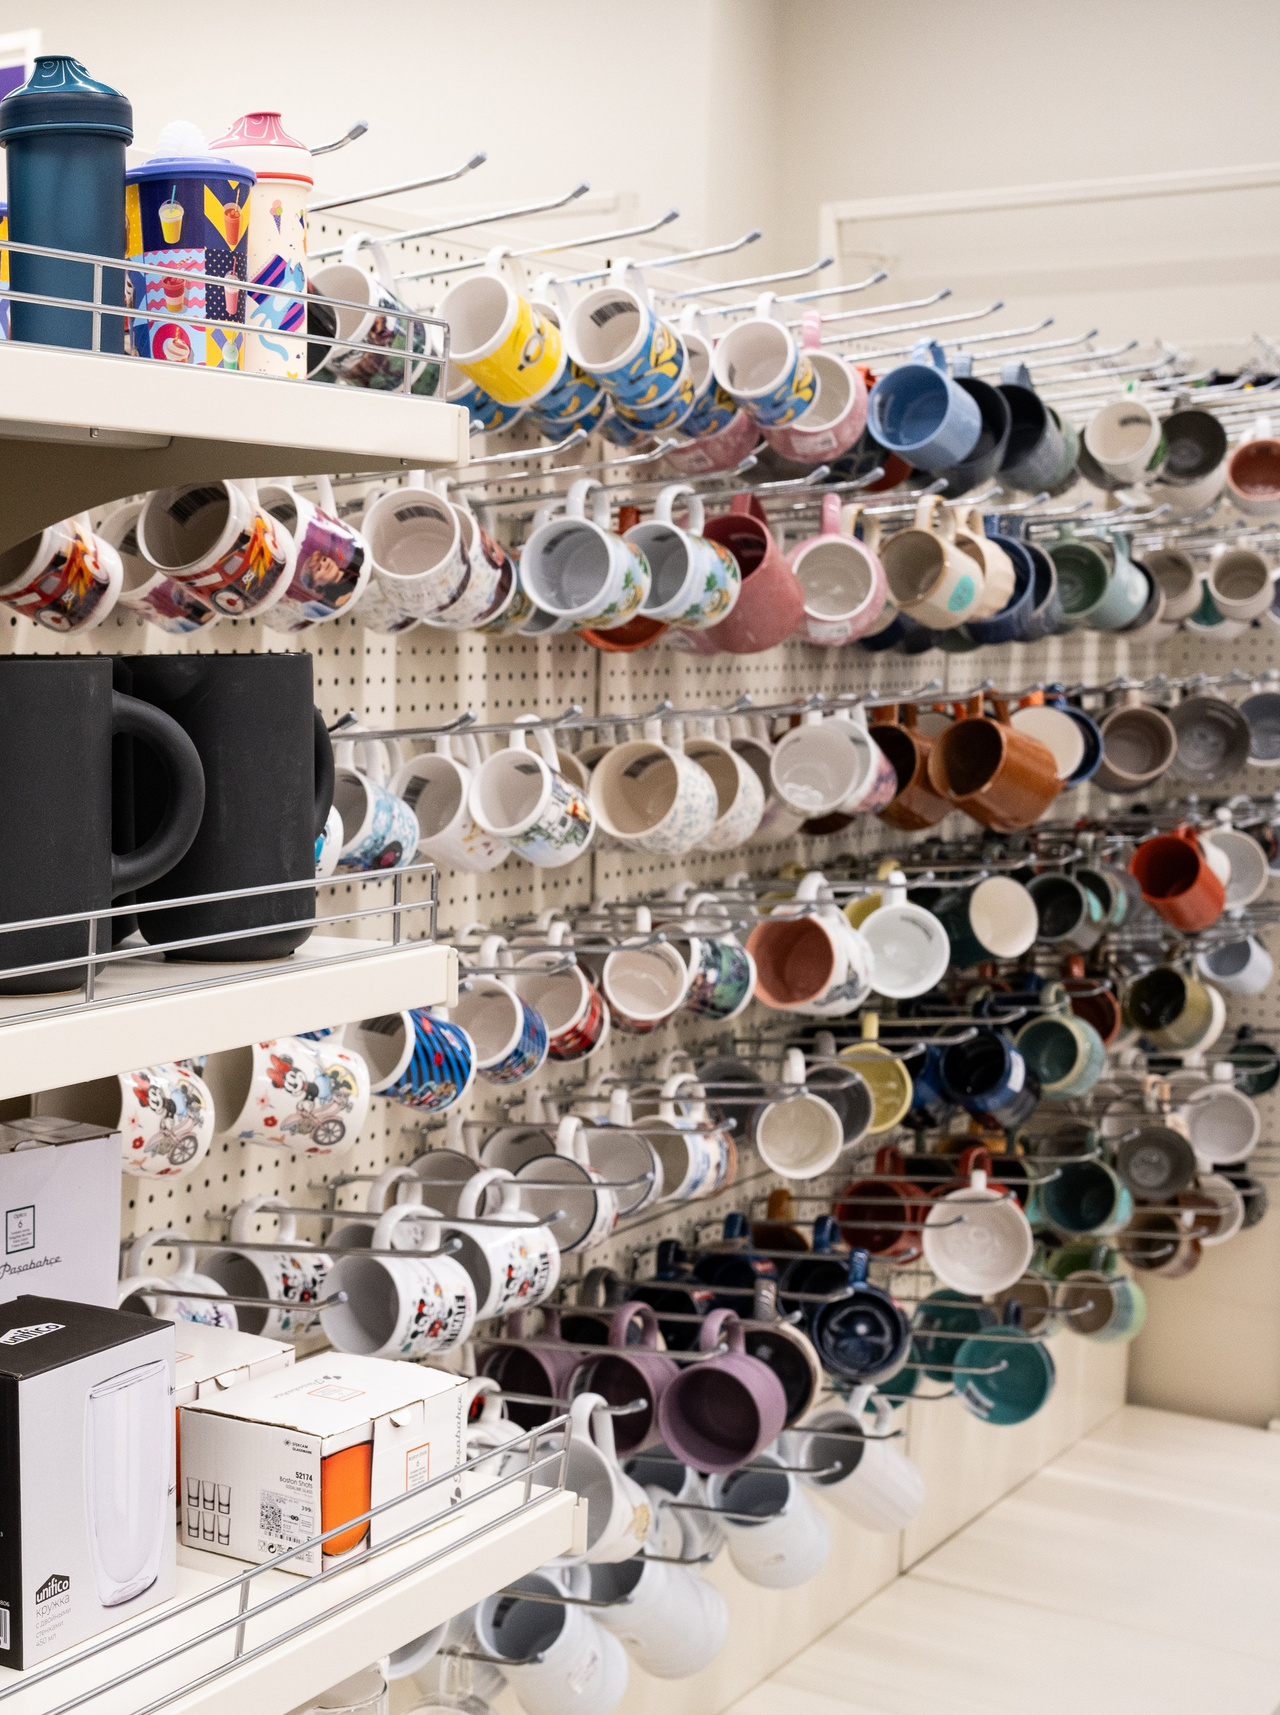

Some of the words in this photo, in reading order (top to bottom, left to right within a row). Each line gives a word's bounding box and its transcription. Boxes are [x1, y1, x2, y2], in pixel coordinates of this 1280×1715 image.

[3, 1325, 59, 1344] unifico
[280, 1475, 298, 1485] Boston
[299, 1480, 313, 1489] Shots
[295, 1471, 313, 1482] 52174
[37, 1577, 69, 1603] unifico
[36, 1594, 70, 1618] кружка
[40, 1607, 71, 1628] двойными
[36, 1620, 64, 1639] стенками
[36, 1636, 47, 1647] 450
[48, 1633, 57, 1642] мл
